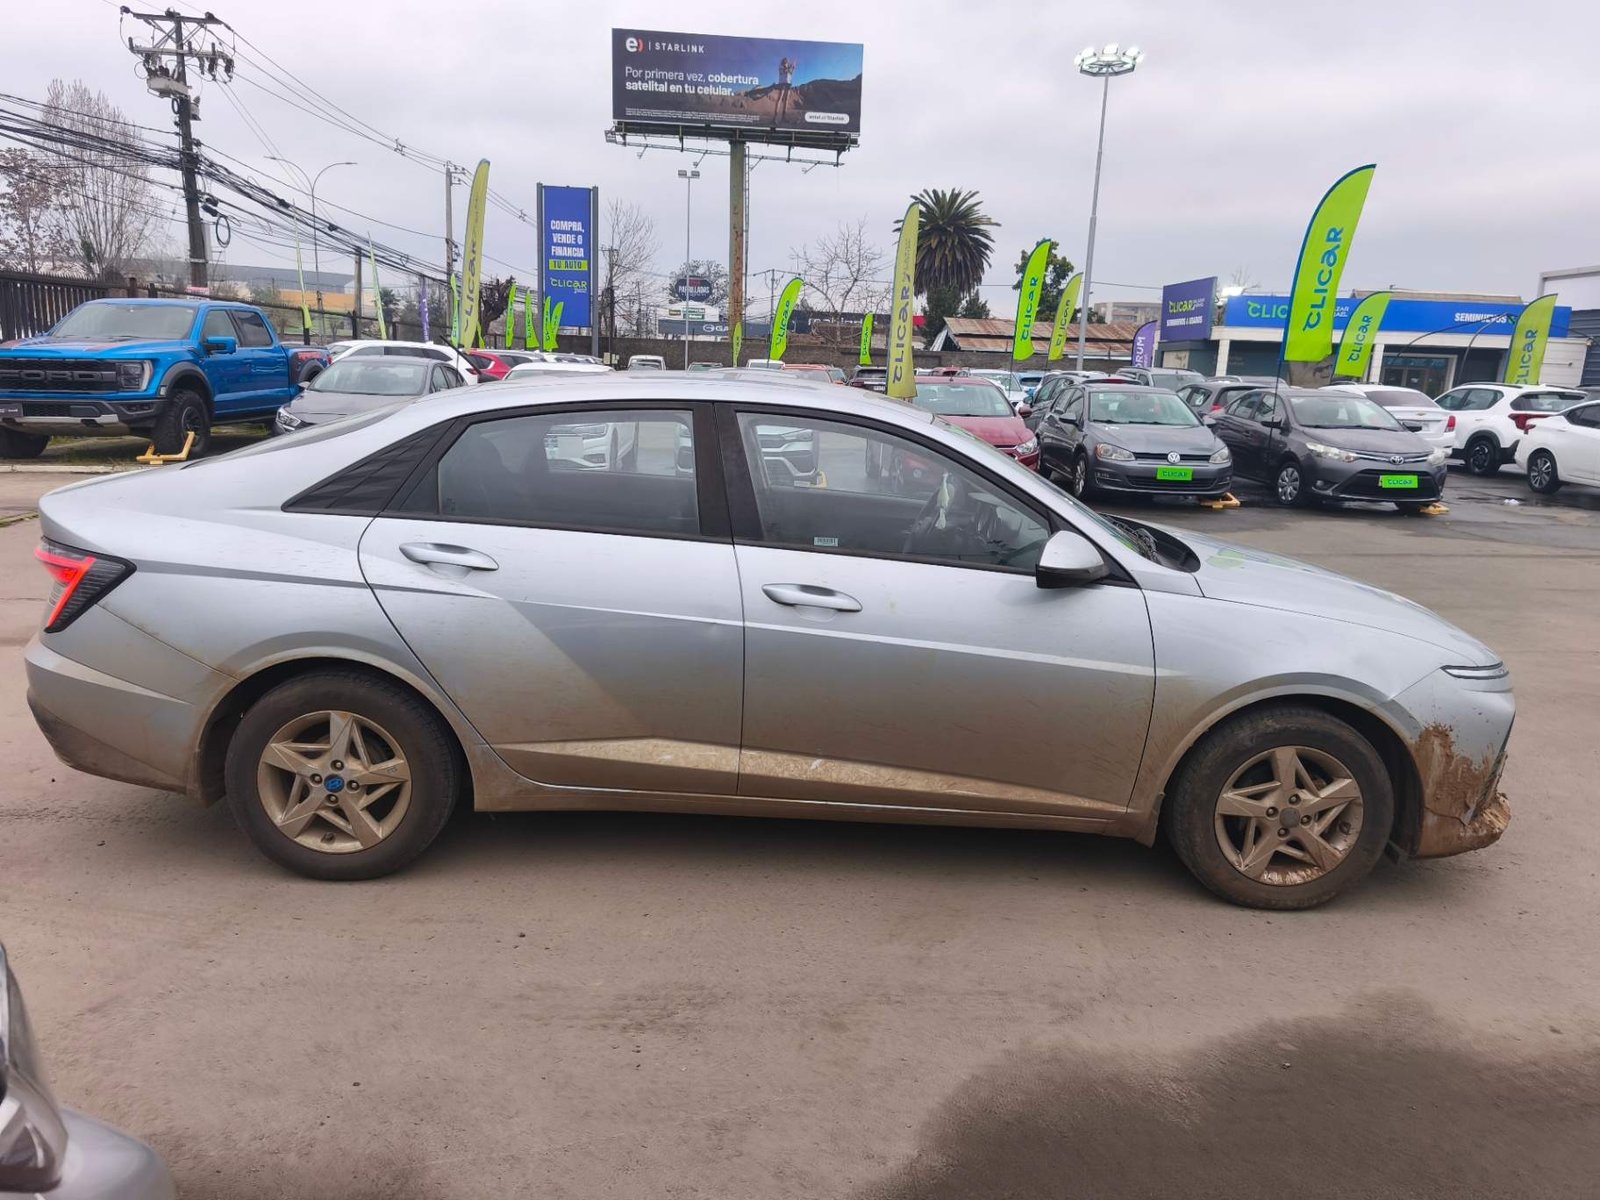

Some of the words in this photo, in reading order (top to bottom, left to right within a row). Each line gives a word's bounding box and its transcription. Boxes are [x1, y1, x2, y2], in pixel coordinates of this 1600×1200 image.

[655, 42, 705, 53] STARLINK
[625, 66, 642, 78] Por
[644, 68, 684, 80] primera
[686, 72, 706, 82] vez,
[708, 73, 759, 85] cobertura
[625, 80, 667, 92] satelital
[669, 84, 682, 93] en
[684, 84, 695, 94] tu
[697, 85, 735, 96] celular.
[550, 219, 585, 233] COMPRA,
[552, 233, 576, 244] VENDE
[551, 246, 585, 257] FINANCIA
